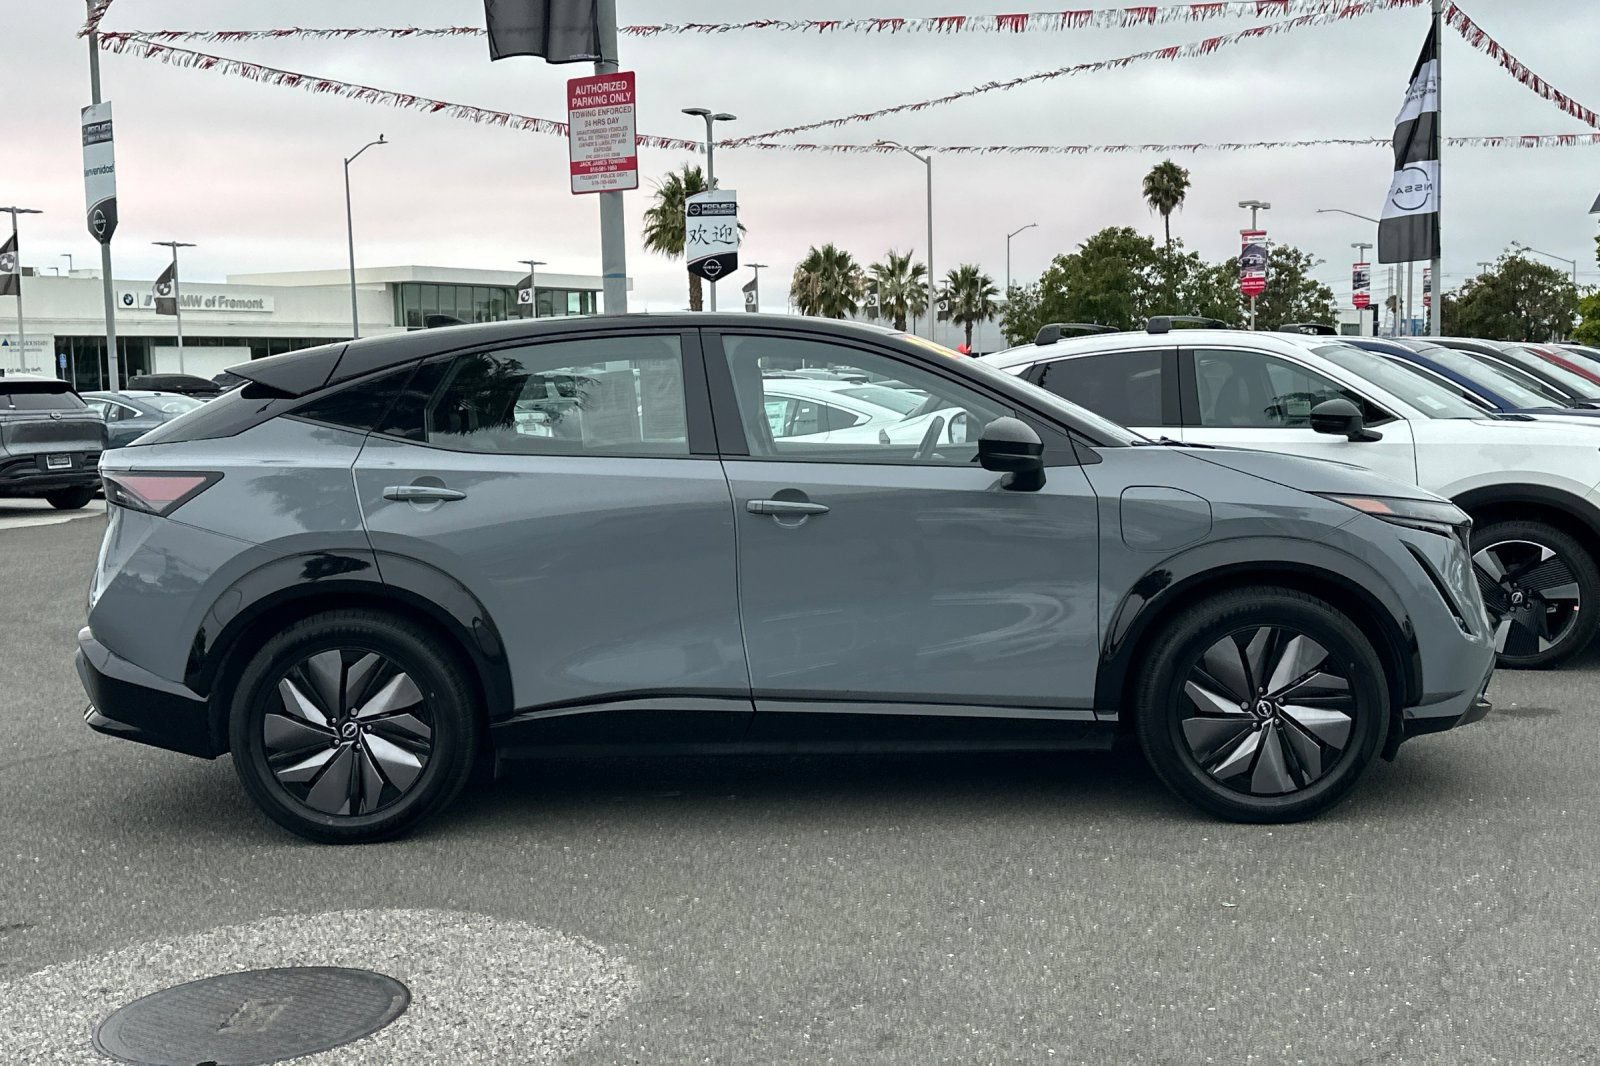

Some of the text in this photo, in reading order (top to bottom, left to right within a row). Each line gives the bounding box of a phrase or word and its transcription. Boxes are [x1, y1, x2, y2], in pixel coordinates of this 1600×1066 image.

[575, 80, 628, 96] AUTHORIZED
[571, 92, 632, 108] PARKING ONLY
[571, 105, 632, 119] TOWING ENFORCED
[592, 118, 606, 127] HRS
[606, 117, 620, 126] DAY
[688, 223, 735, 246] 欢迎
[179, 294, 264, 310] MW of Fremont
